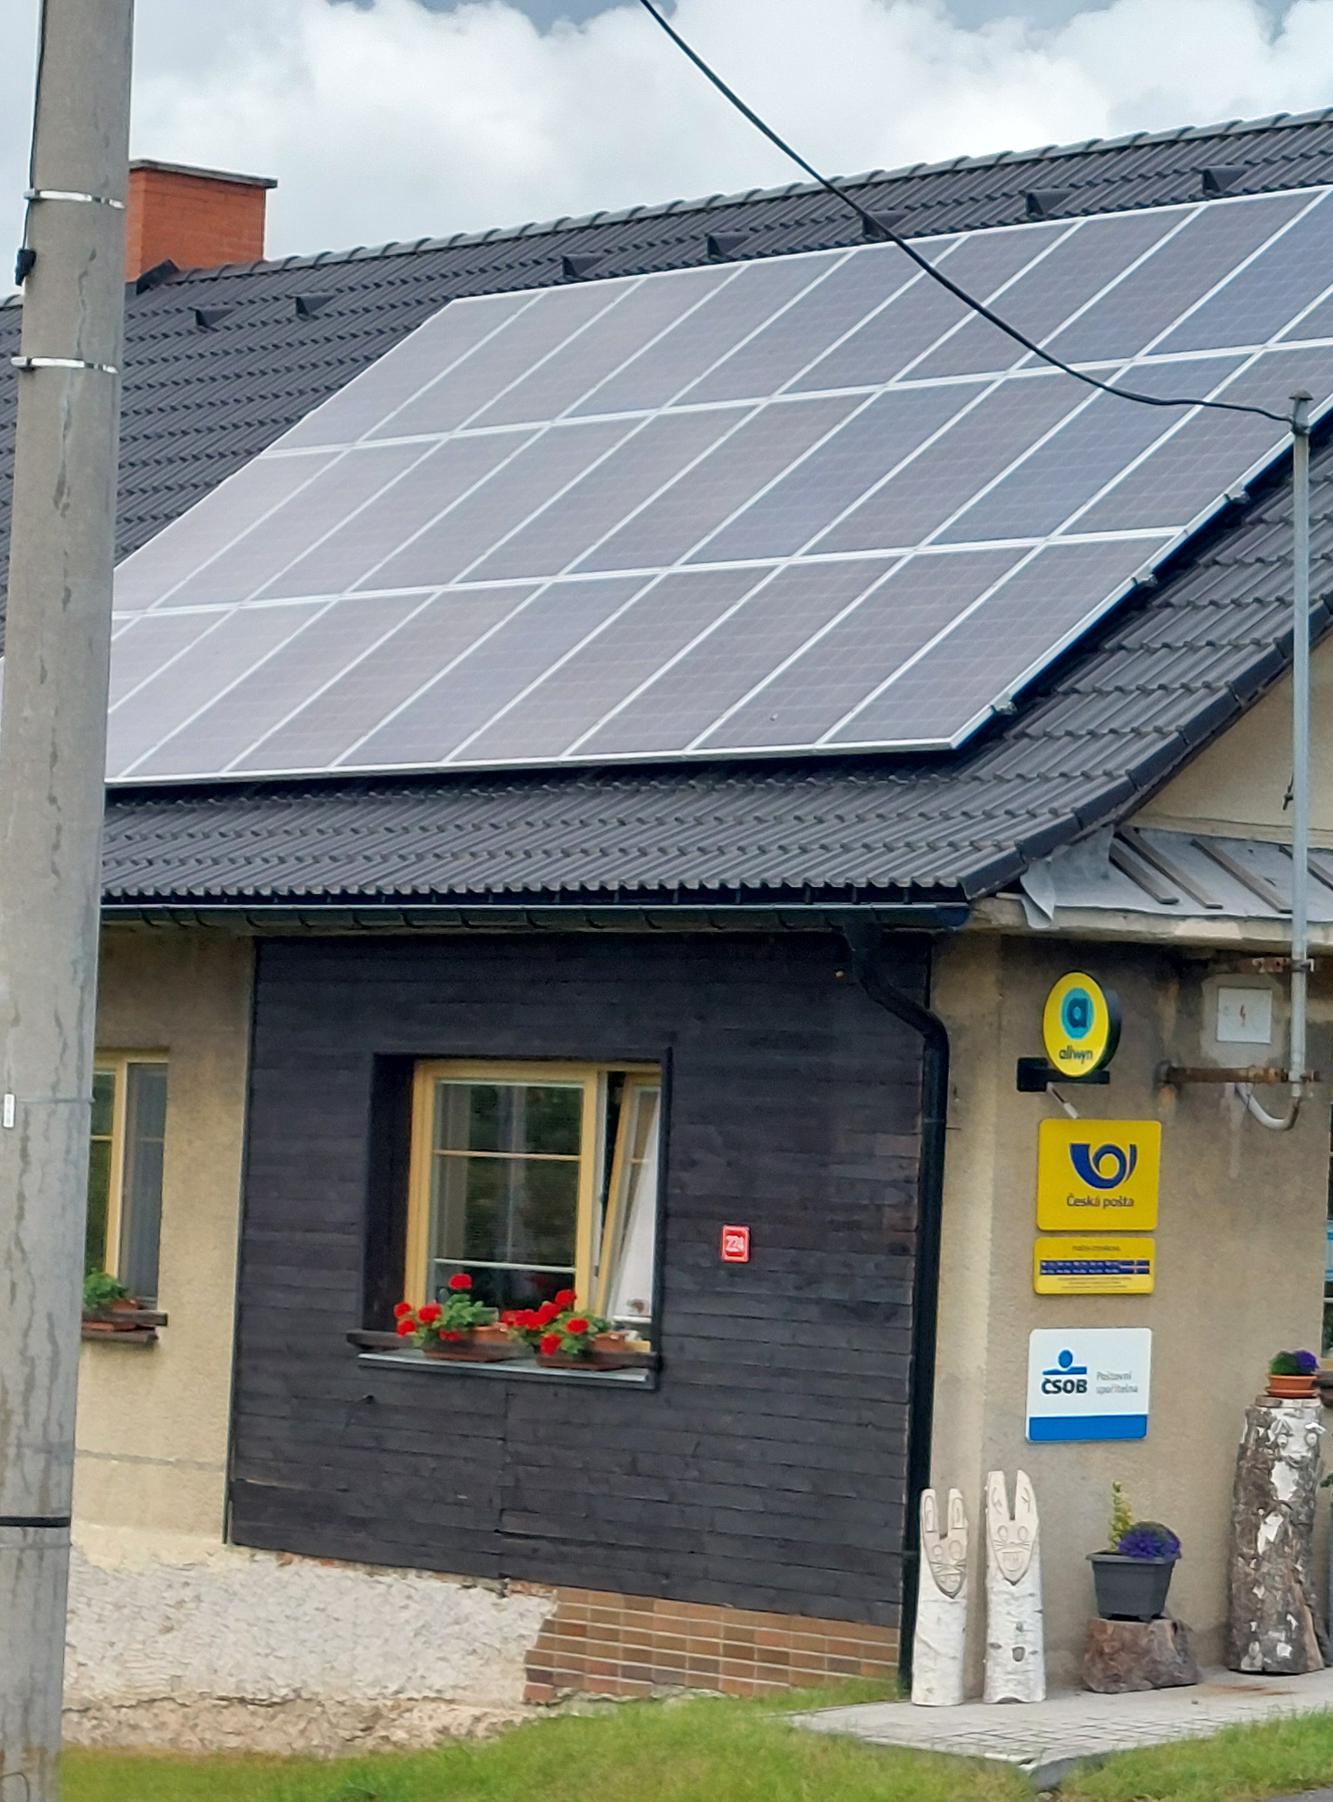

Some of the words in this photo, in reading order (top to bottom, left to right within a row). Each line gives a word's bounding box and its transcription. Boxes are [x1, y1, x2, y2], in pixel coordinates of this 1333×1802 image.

[1066, 1193, 1100, 1208] Česká
[1103, 1194, 1134, 1209] pošta
[1041, 1377, 1088, 1395] ČSOB
